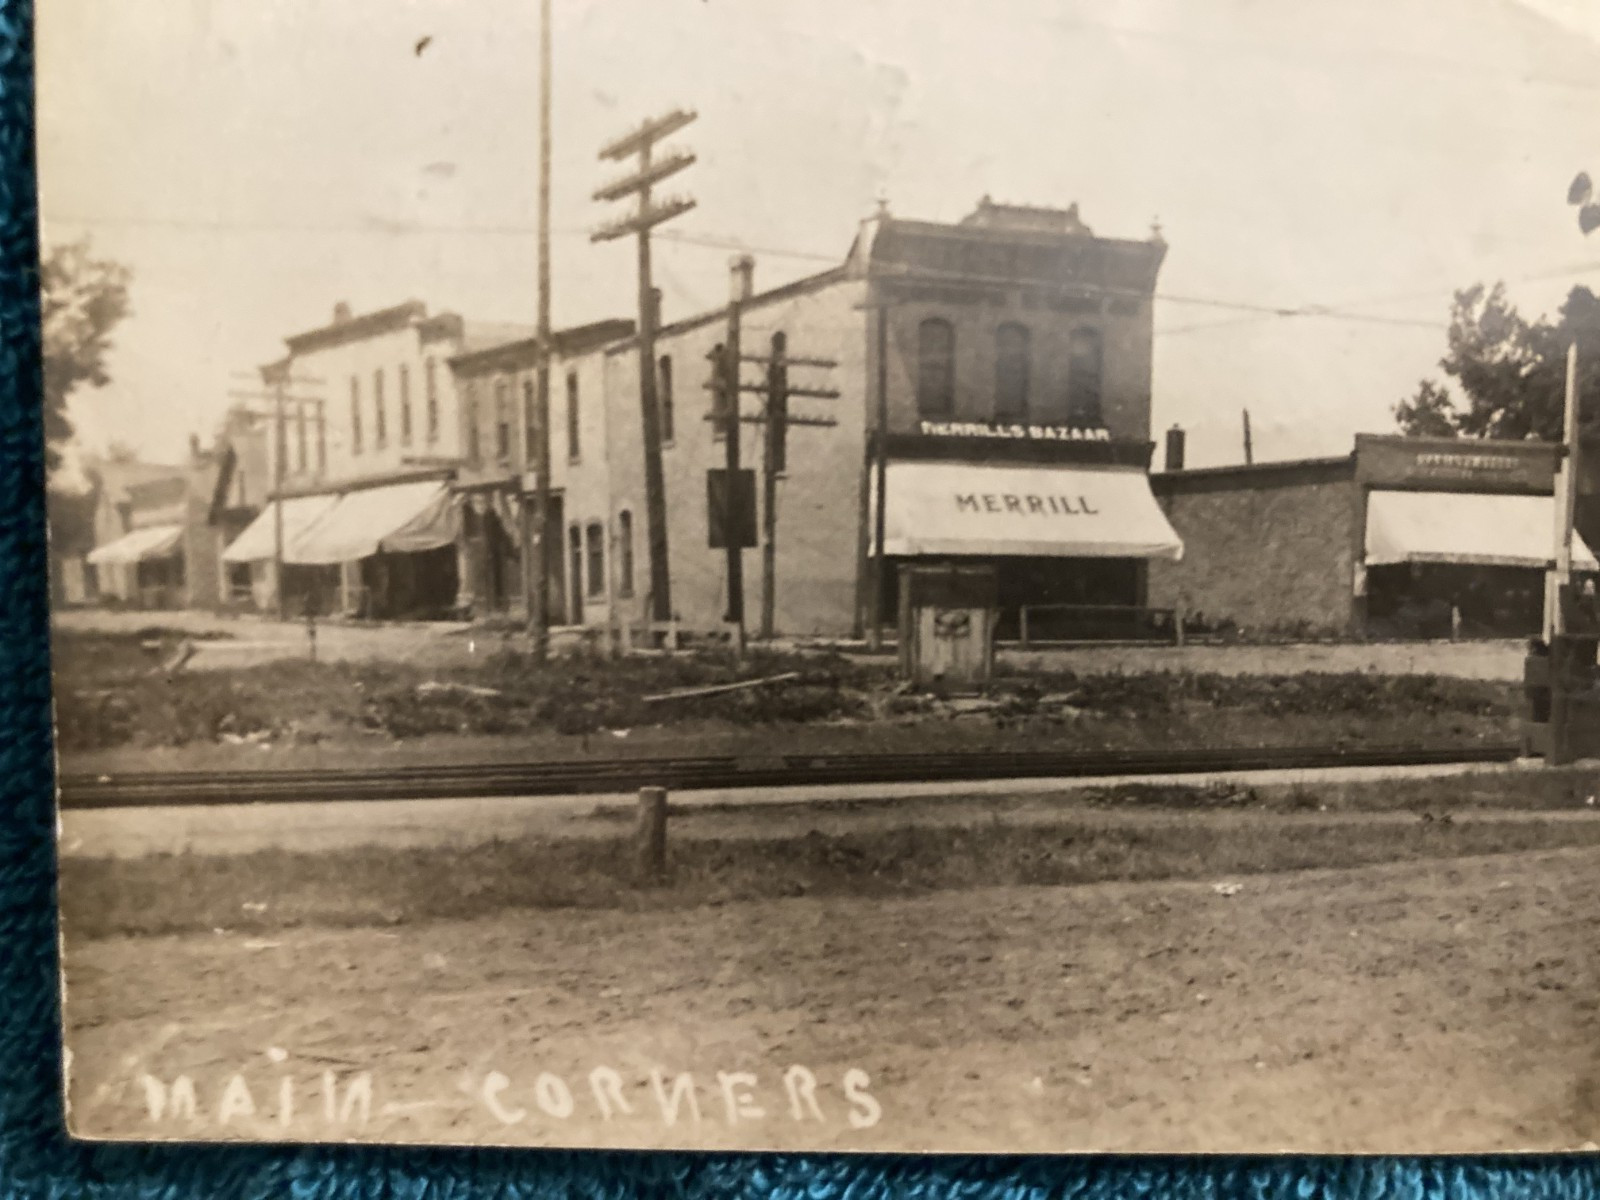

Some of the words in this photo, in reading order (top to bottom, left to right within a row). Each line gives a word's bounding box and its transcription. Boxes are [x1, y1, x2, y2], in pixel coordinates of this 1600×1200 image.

[1028, 425, 1110, 442] BAZAAR
[955, 493, 1099, 516] MERRILL
[482, 1064, 882, 1128] CORNERS
